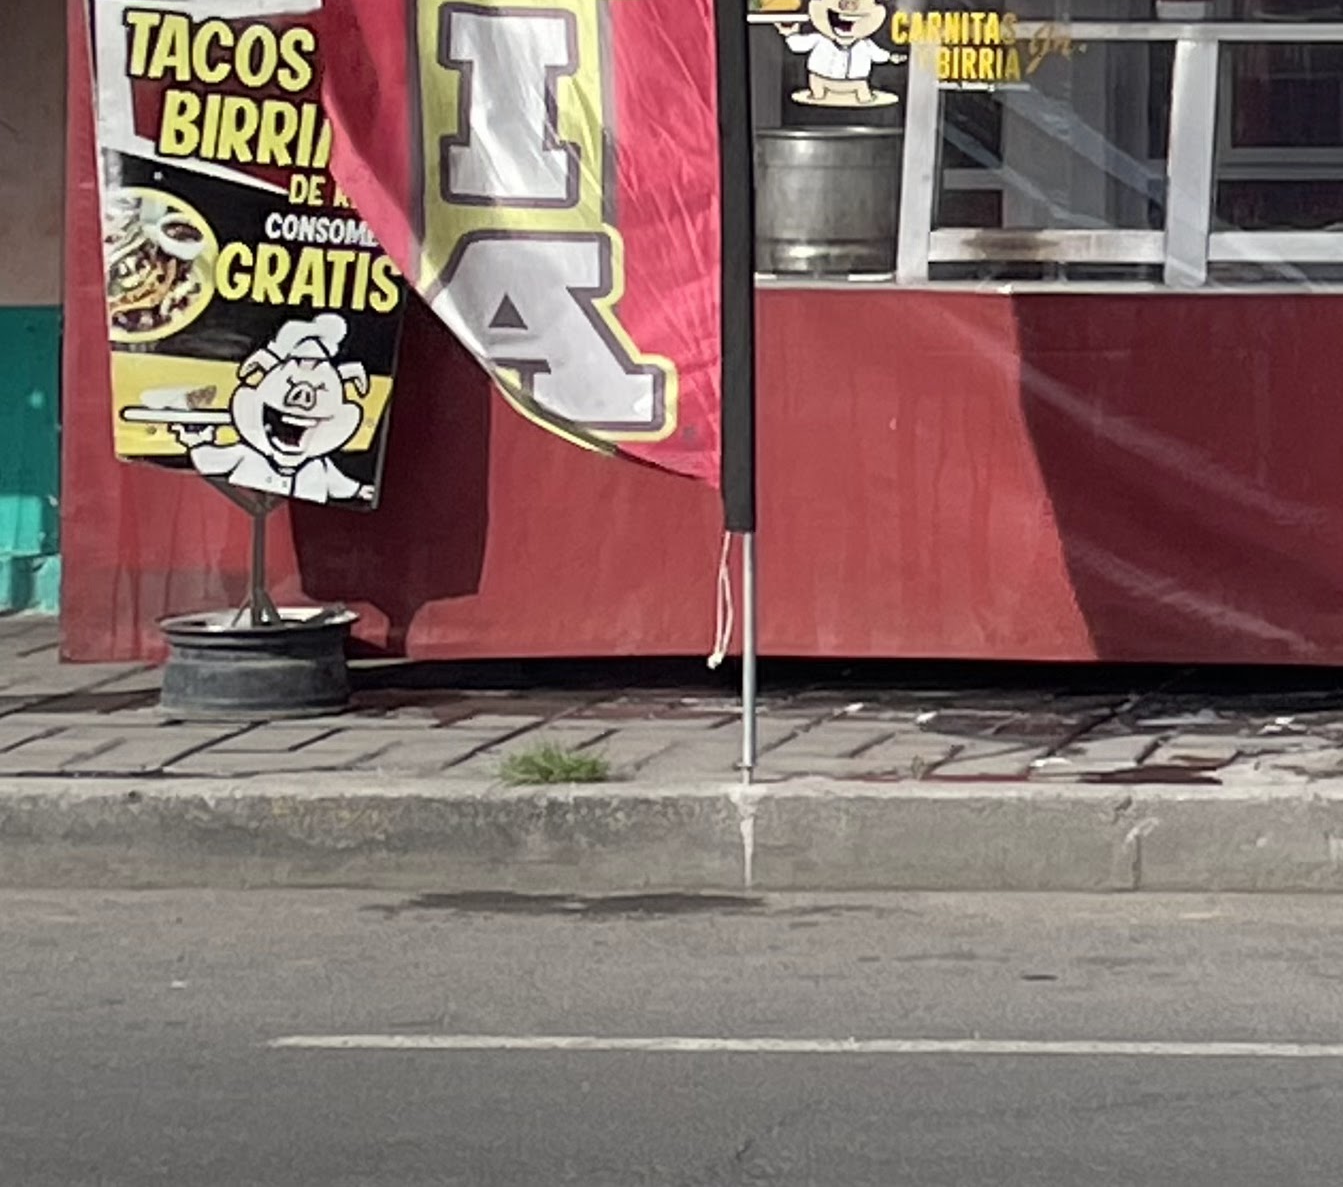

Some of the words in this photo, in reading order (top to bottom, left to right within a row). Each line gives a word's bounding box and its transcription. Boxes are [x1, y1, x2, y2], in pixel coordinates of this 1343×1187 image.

[891, 11, 1019, 47] CARNITAS
[126, 11, 316, 92] TACOS
[936, 46, 1022, 81] BIRRIA
[288, 174, 327, 207] DE
[215, 242, 403, 313] GRATIS
